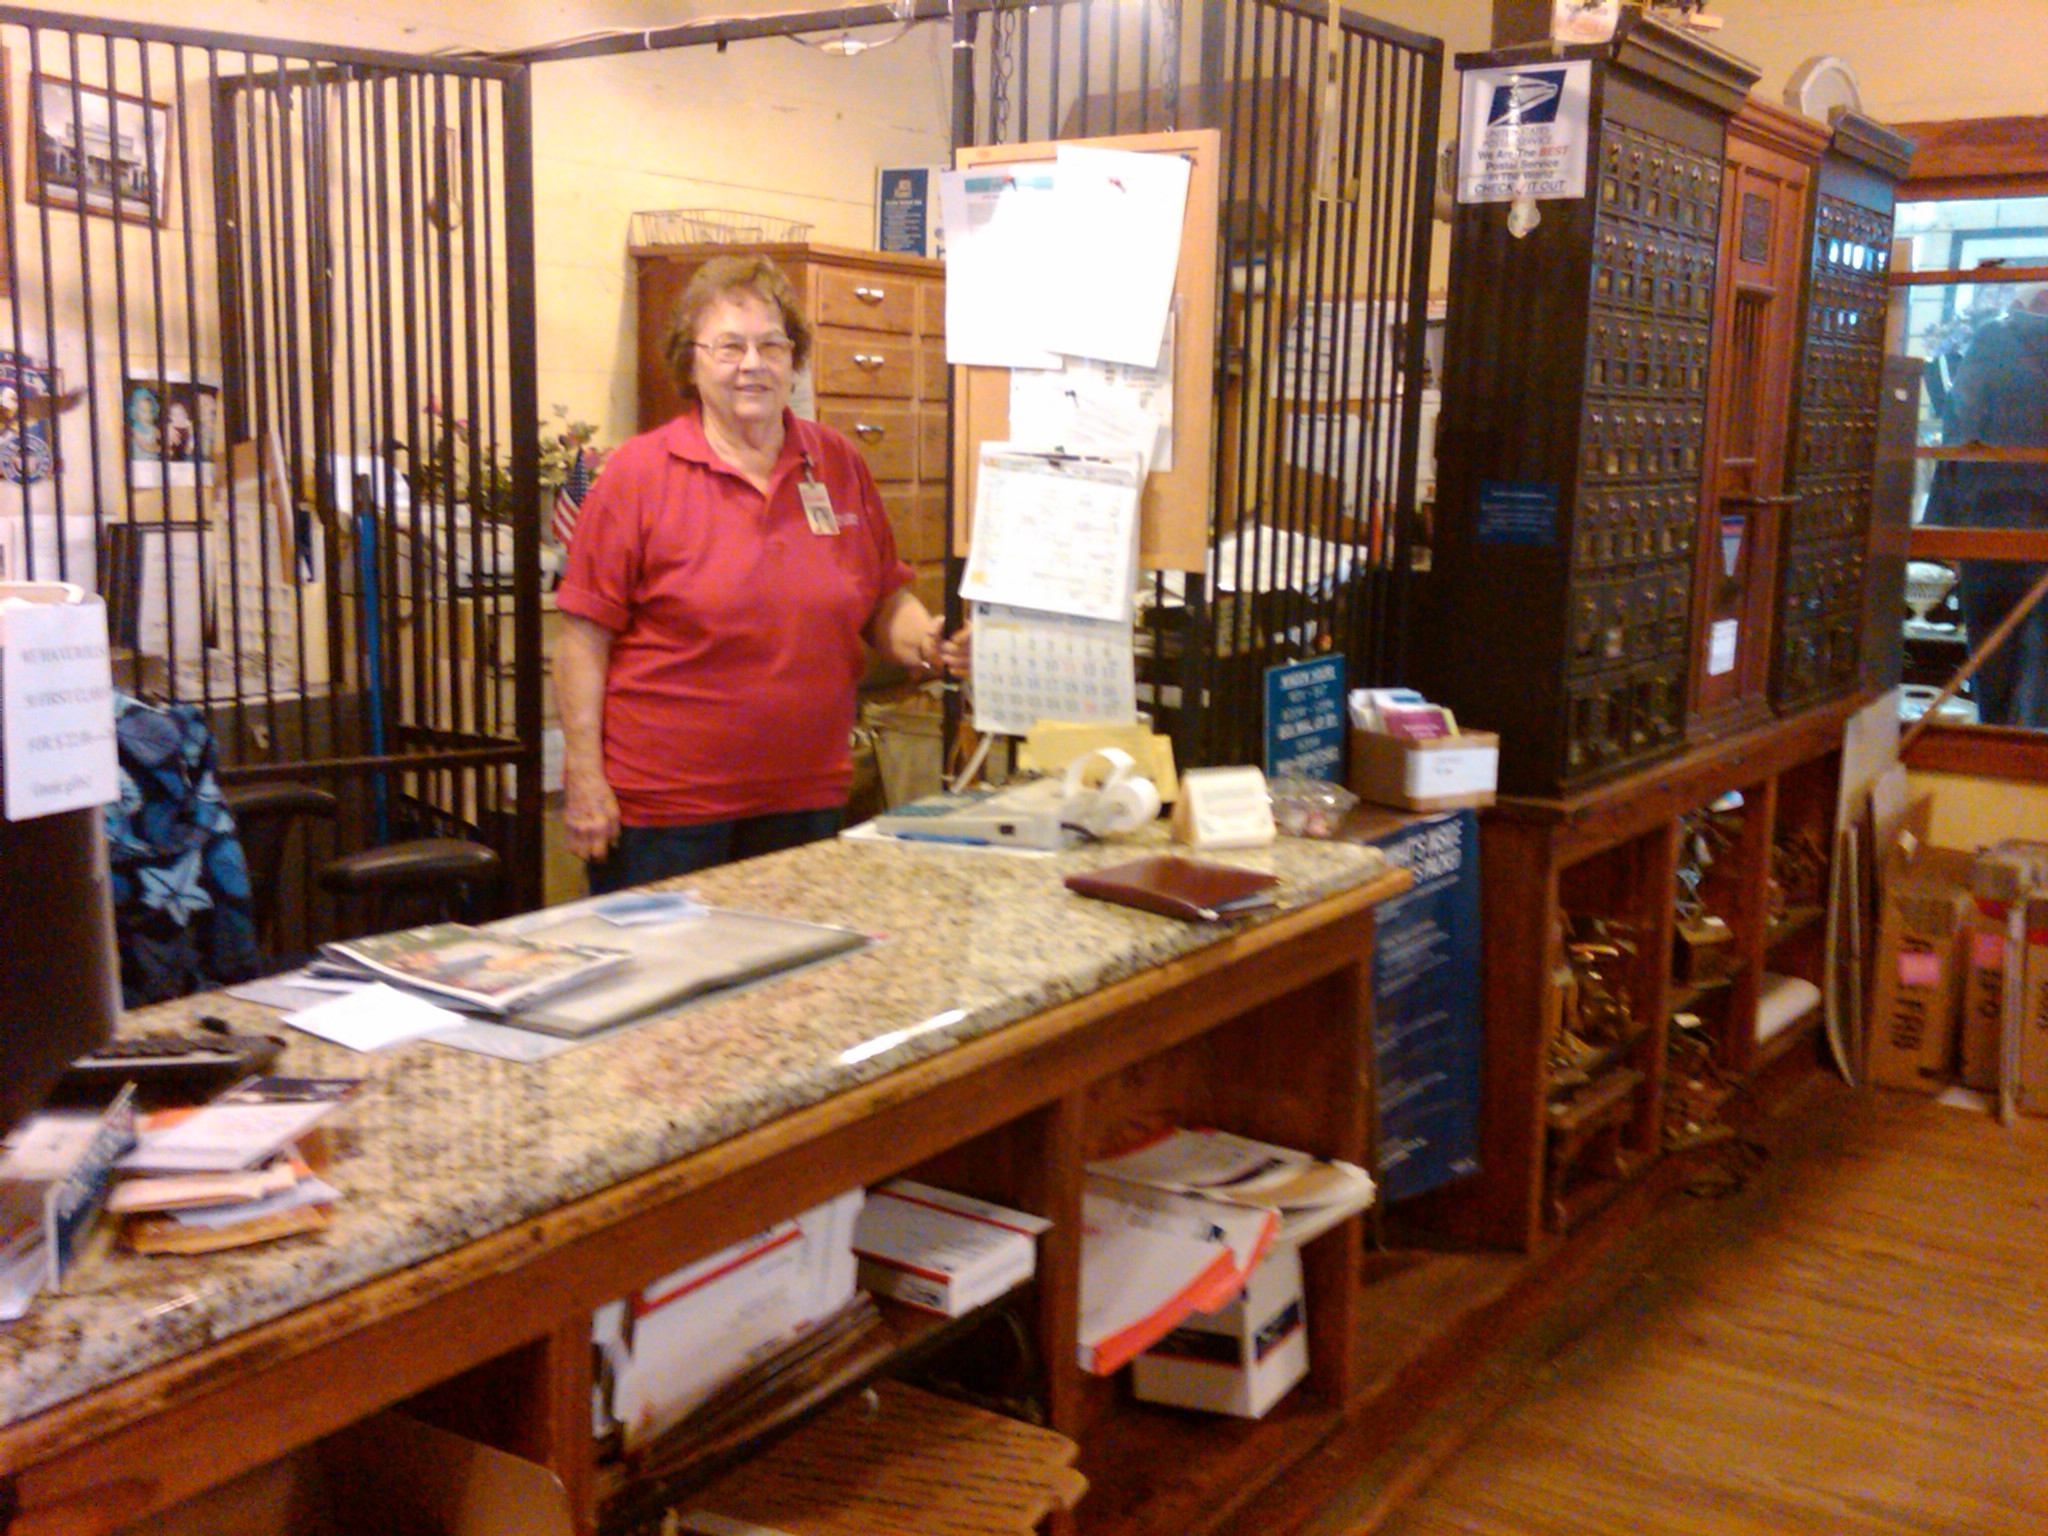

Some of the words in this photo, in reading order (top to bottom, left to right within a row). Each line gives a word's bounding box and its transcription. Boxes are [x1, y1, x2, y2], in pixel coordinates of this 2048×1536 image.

[1478, 150, 1495, 160] We
[1496, 149, 1515, 159] Are
[1517, 148, 1537, 158] The
[1538, 145, 1569, 156] BEST
[1486, 160, 1518, 172] Postal
[1520, 158, 1560, 169] Service
[1474, 183, 1515, 195] CHECK
[1526, 181, 1539, 190] IT
[1540, 179, 1567, 190] OUT
